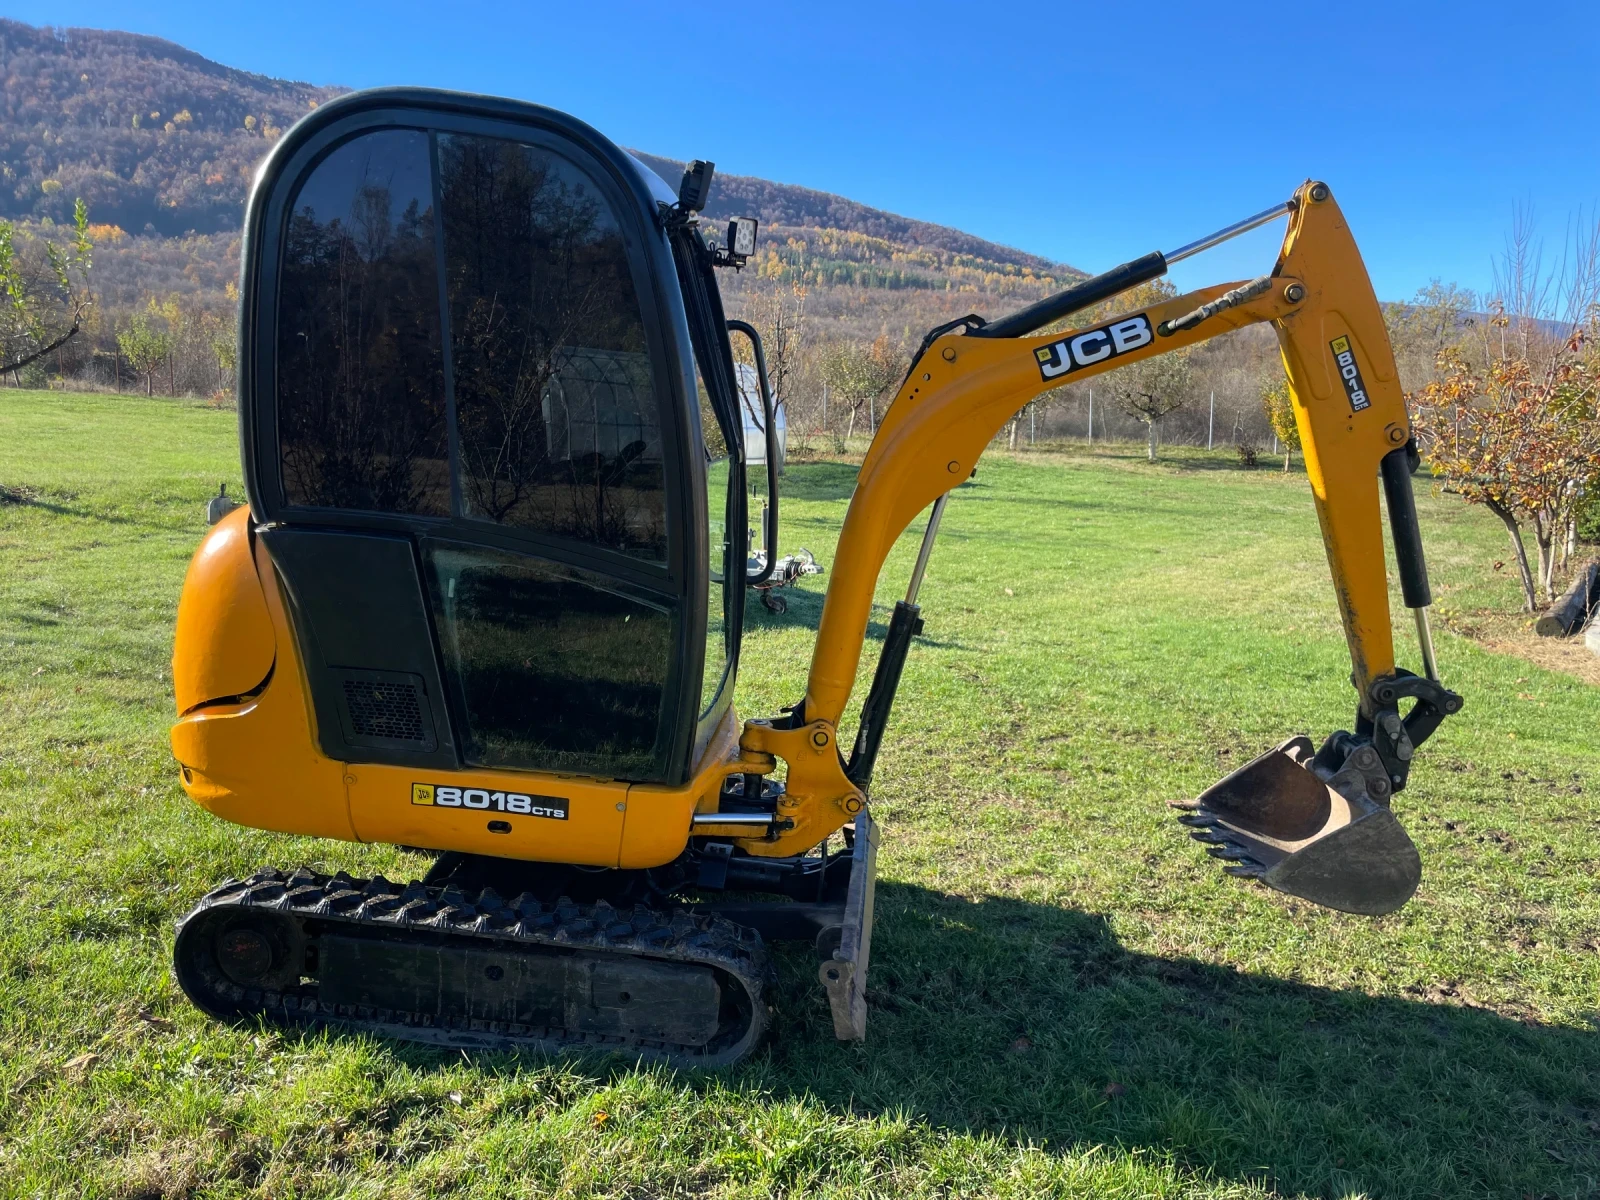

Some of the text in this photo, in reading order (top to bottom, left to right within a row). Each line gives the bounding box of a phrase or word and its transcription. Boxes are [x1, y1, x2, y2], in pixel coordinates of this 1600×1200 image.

[1041, 317, 1152, 377] JCB
[1337, 351, 1366, 405] 8018
[436, 787, 565, 818] 8018 CTS
